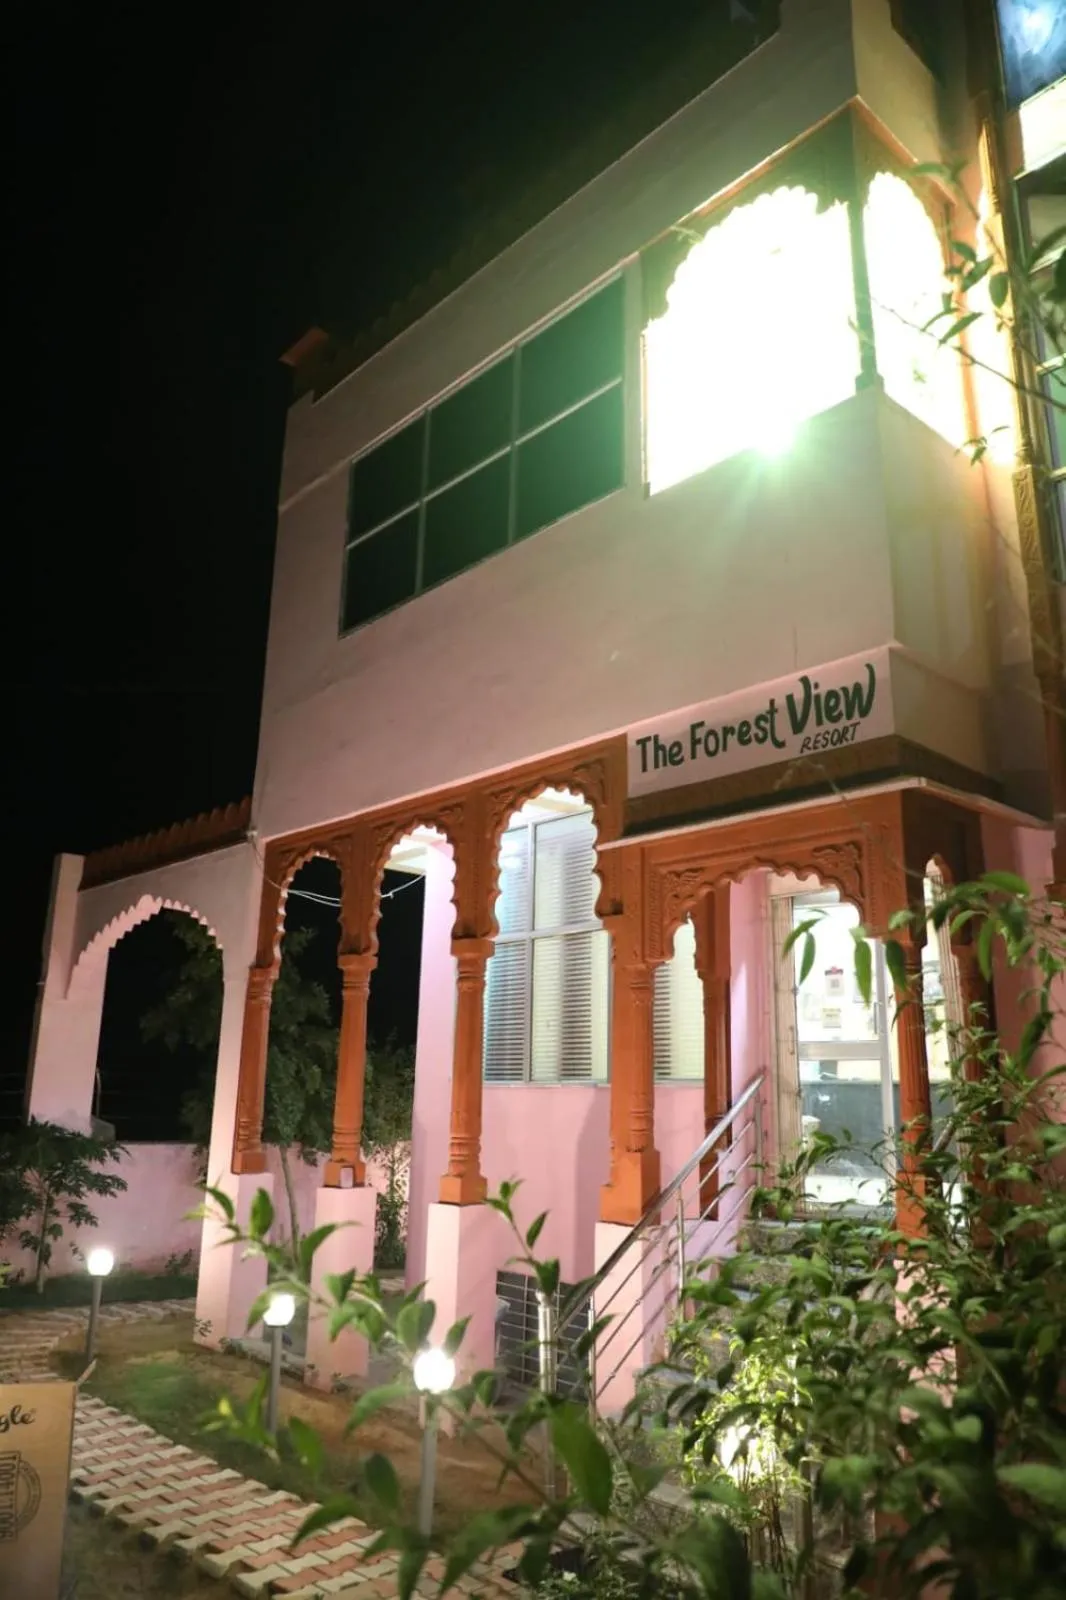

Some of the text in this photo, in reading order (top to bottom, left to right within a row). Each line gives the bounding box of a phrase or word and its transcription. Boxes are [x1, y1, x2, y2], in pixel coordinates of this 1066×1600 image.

[636, 663, 876, 773] The Forest View
[800, 721, 861, 754] RESORT
